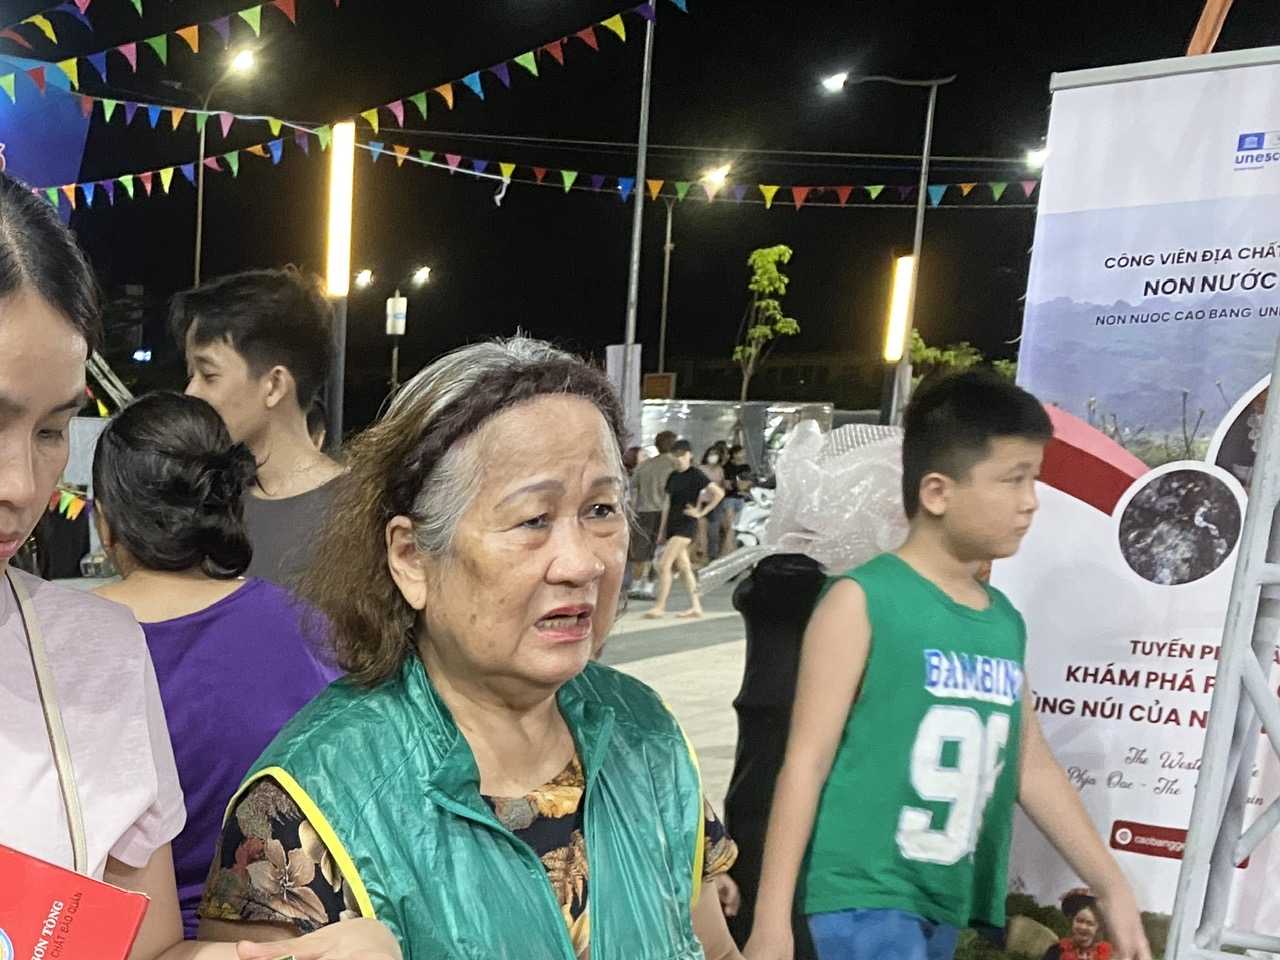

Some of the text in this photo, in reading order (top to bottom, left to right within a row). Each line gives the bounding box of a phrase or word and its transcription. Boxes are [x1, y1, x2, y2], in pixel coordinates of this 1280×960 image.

[1235, 151, 1280, 165] unesc
[1104, 253, 1155, 269] CÔNG
[1160, 248, 1197, 265] VIÊN
[1201, 247, 1233, 264] ĐỊA
[1143, 268, 1278, 296] NON NƯỚC
[1095, 314, 1127, 326] NON
[1130, 311, 1171, 324] NUOC
[1174, 309, 1206, 321] CAO
[1209, 307, 1252, 319] BANG
[1129, 638, 1196, 659] TUYẾN
[1065, 662, 1140, 688] KHÁM
[1143, 668, 1196, 693] PHÁ
[1081, 697, 1124, 720] NÚI
[1129, 700, 1182, 727] CỦA
[1125, 747, 1148, 766] The
[1153, 777, 1183, 796] The
[42, 901, 65, 937] TÒNG
